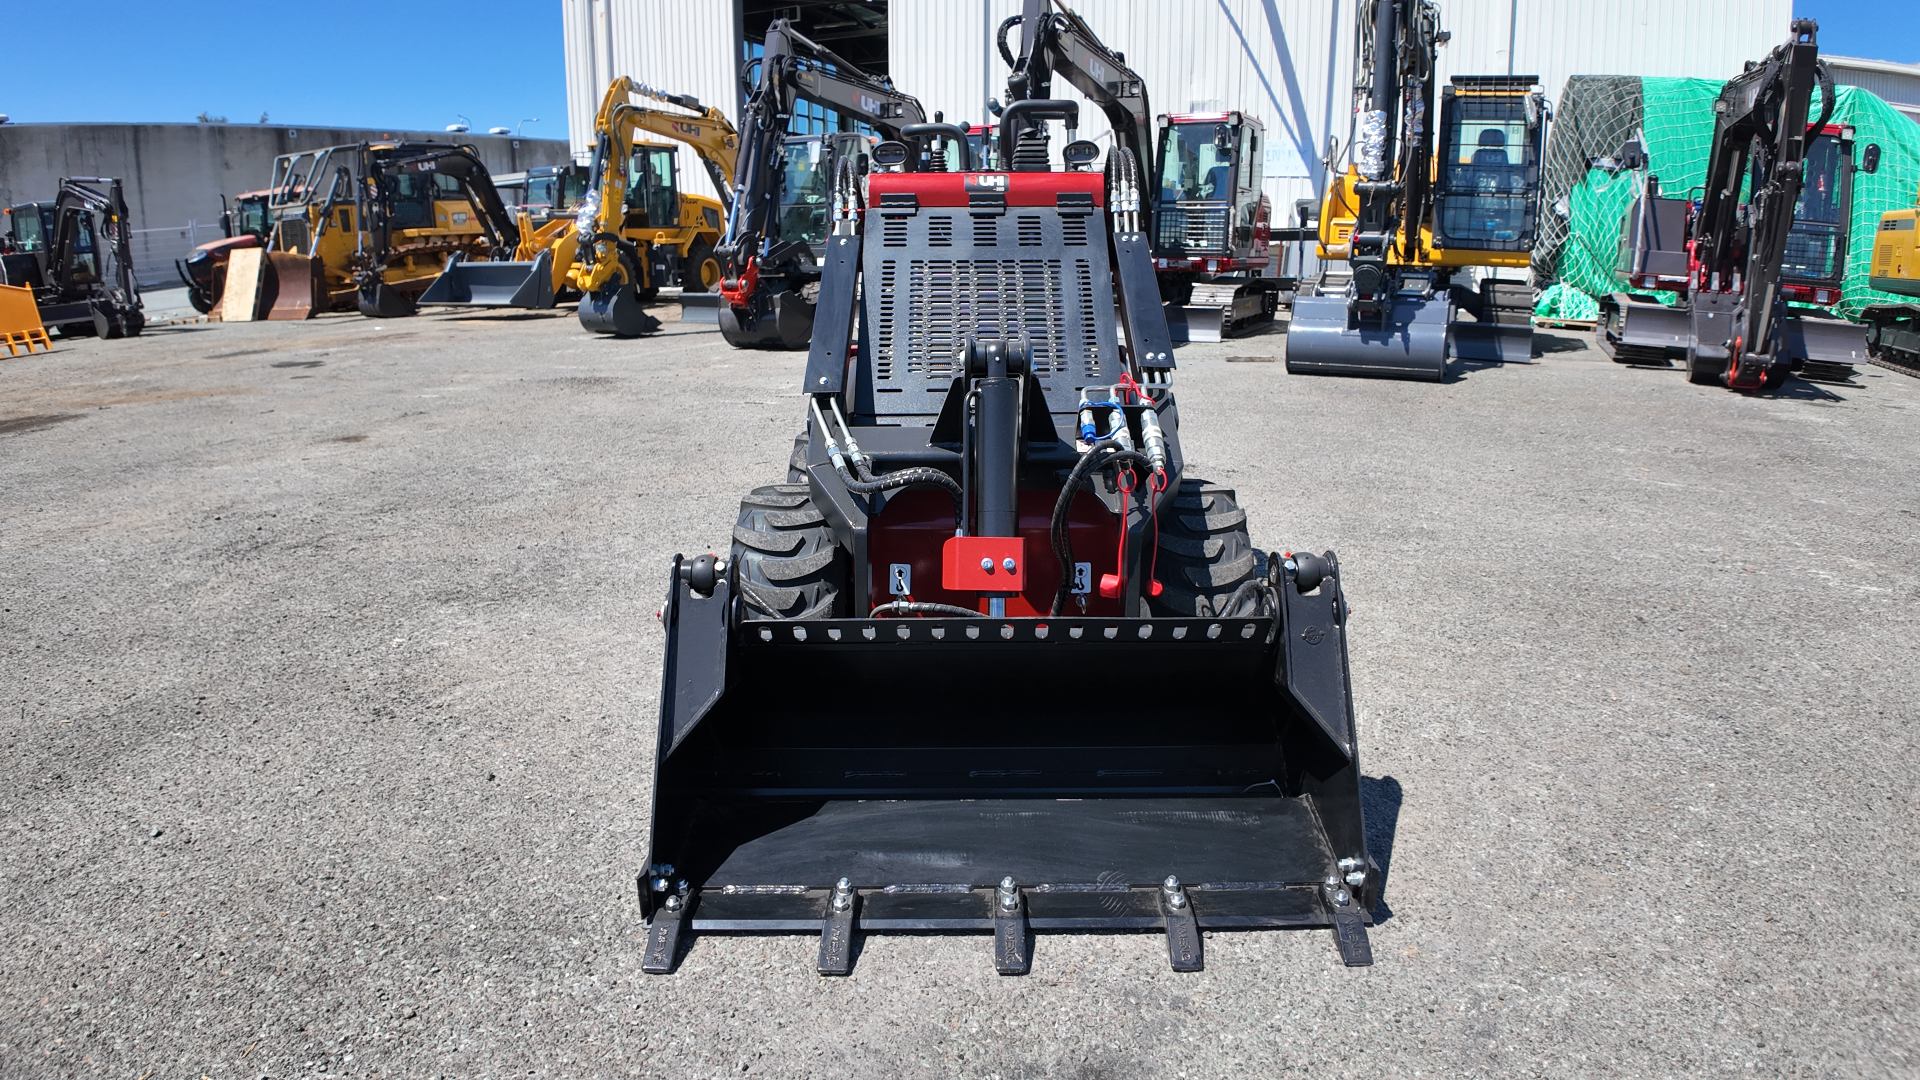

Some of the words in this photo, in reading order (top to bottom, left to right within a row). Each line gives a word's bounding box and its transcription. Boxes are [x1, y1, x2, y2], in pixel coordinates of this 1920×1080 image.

[861, 95, 881, 116] UHI
[680, 122, 700, 137] UHI
[417, 161, 436, 171] UHI
[978, 175, 1004, 187] UHI
